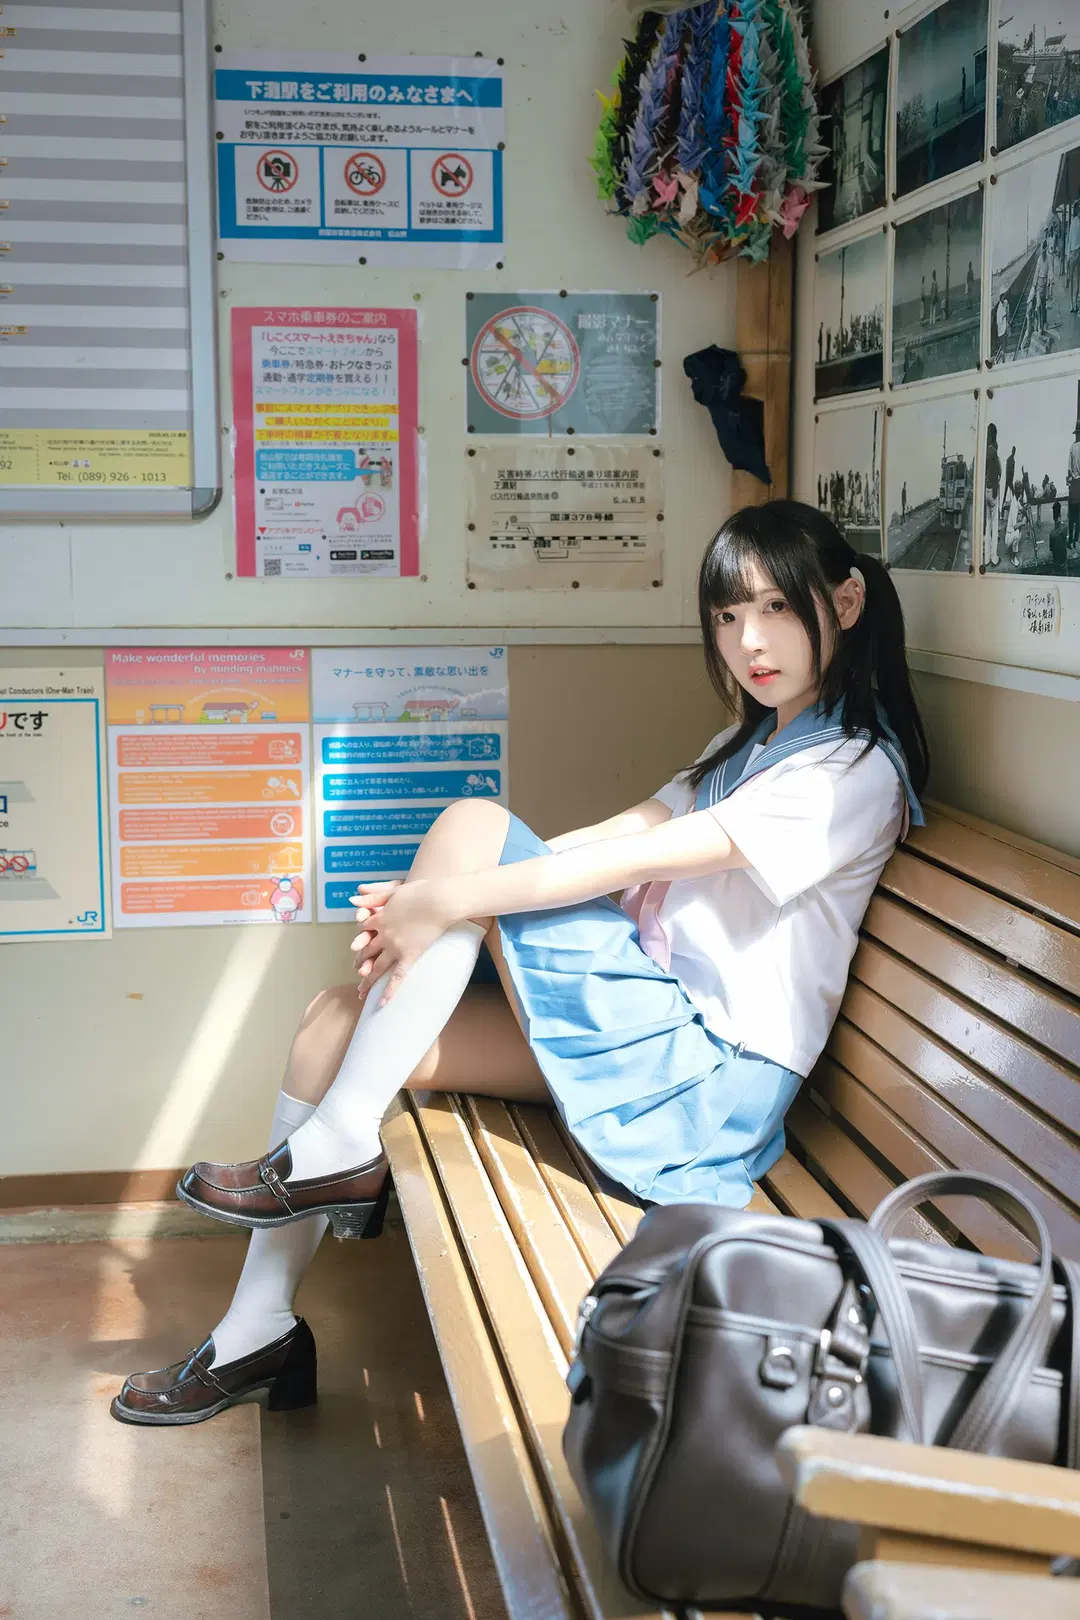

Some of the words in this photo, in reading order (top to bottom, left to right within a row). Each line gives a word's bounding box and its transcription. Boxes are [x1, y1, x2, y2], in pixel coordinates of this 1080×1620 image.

[245, 80, 473, 103] 下灘駅をご利用のみなさまへ
[264, 310, 387, 325] スマホ乗車券のご案内
[261, 332, 396, 344] 「しこくスマートえきちゃん」なら
[269, 346, 384, 357] 今ここでスマートフォンから
[56, 472, 74, 481] Tel.
[78, 472, 106, 482] (089)
[110, 472, 130, 482] 926
[141, 472, 167, 482] 1013
[550, 513, 614, 522] 国道378号線
[112, 653, 143, 663] Make
[146, 652, 205, 663] wonderful
[208, 653, 265, 663] memories
[290, 649, 305, 659] JR
[489, 648, 505, 657] JR
[194, 664, 207, 676] by
[210, 664, 253, 675] minding
[256, 664, 302, 673] manners
[332, 665, 489, 678] マナーを守って、素敵な思い出を
[9, 687, 44, 695] Conductors
[77, 911, 98, 922] JR
